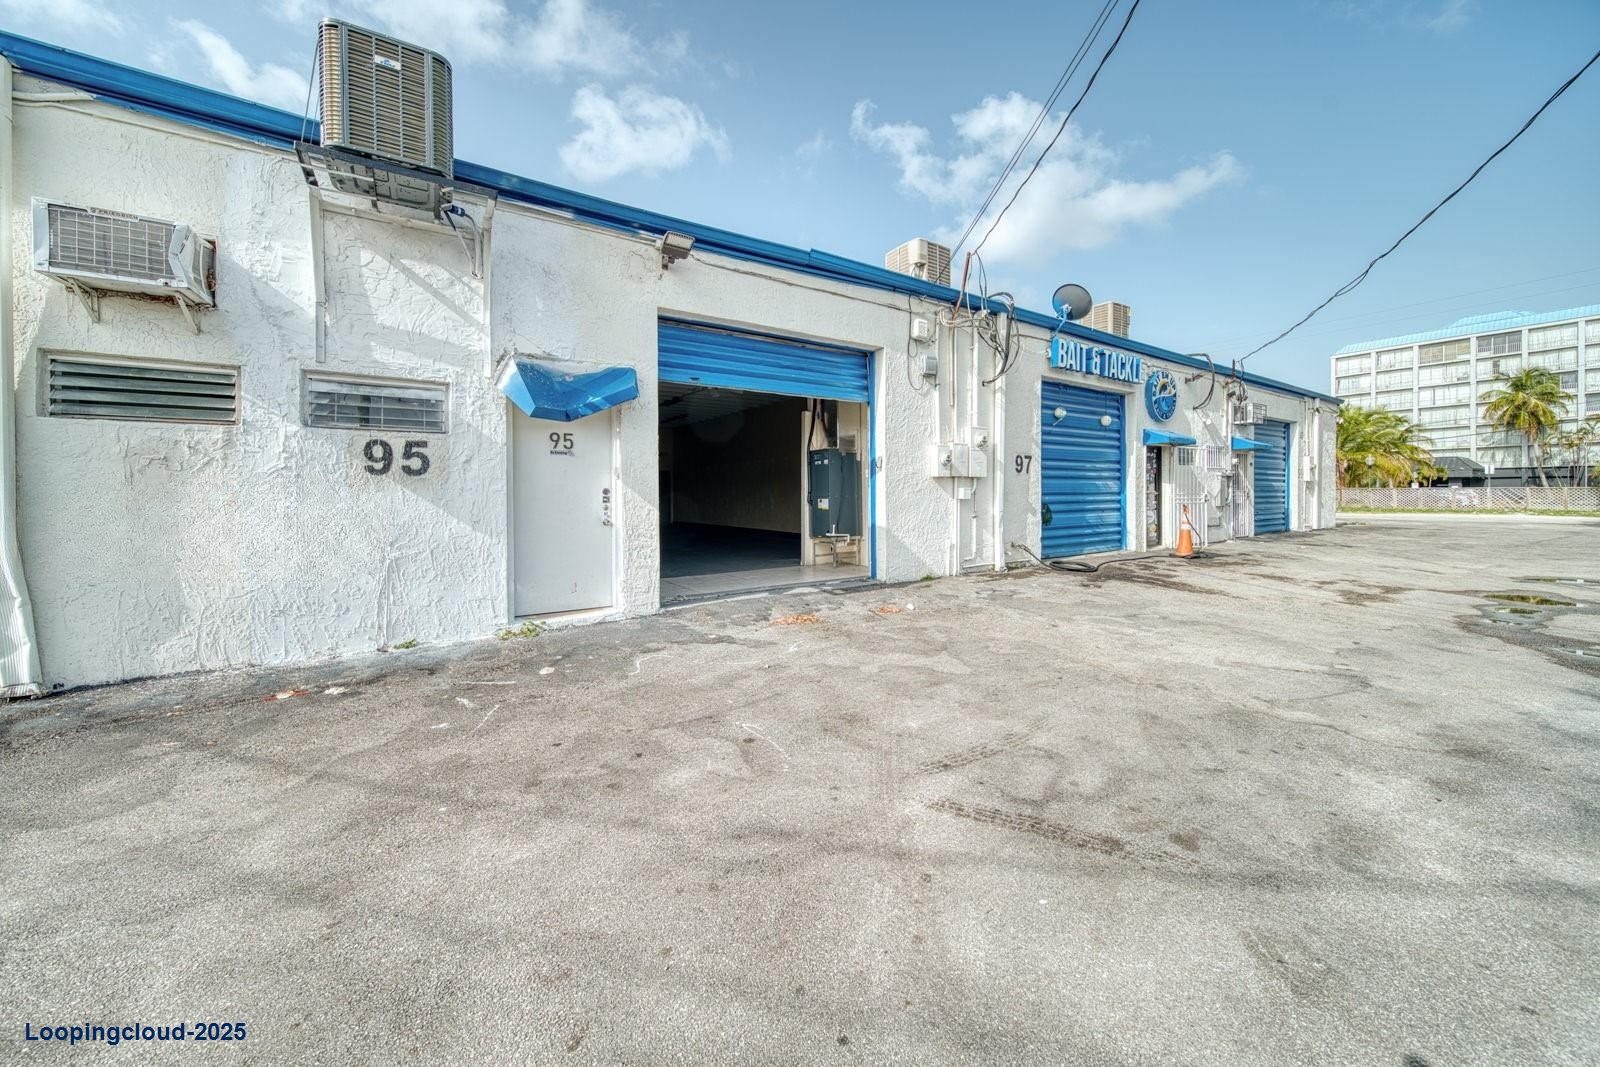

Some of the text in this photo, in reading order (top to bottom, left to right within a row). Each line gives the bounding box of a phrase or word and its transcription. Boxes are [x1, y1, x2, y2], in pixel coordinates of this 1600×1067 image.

[1058, 338, 1143, 383] BAIT & TACKLE
[549, 432, 574, 450] 95
[363, 439, 430, 476] 95
[1015, 454, 1032, 474] 97
